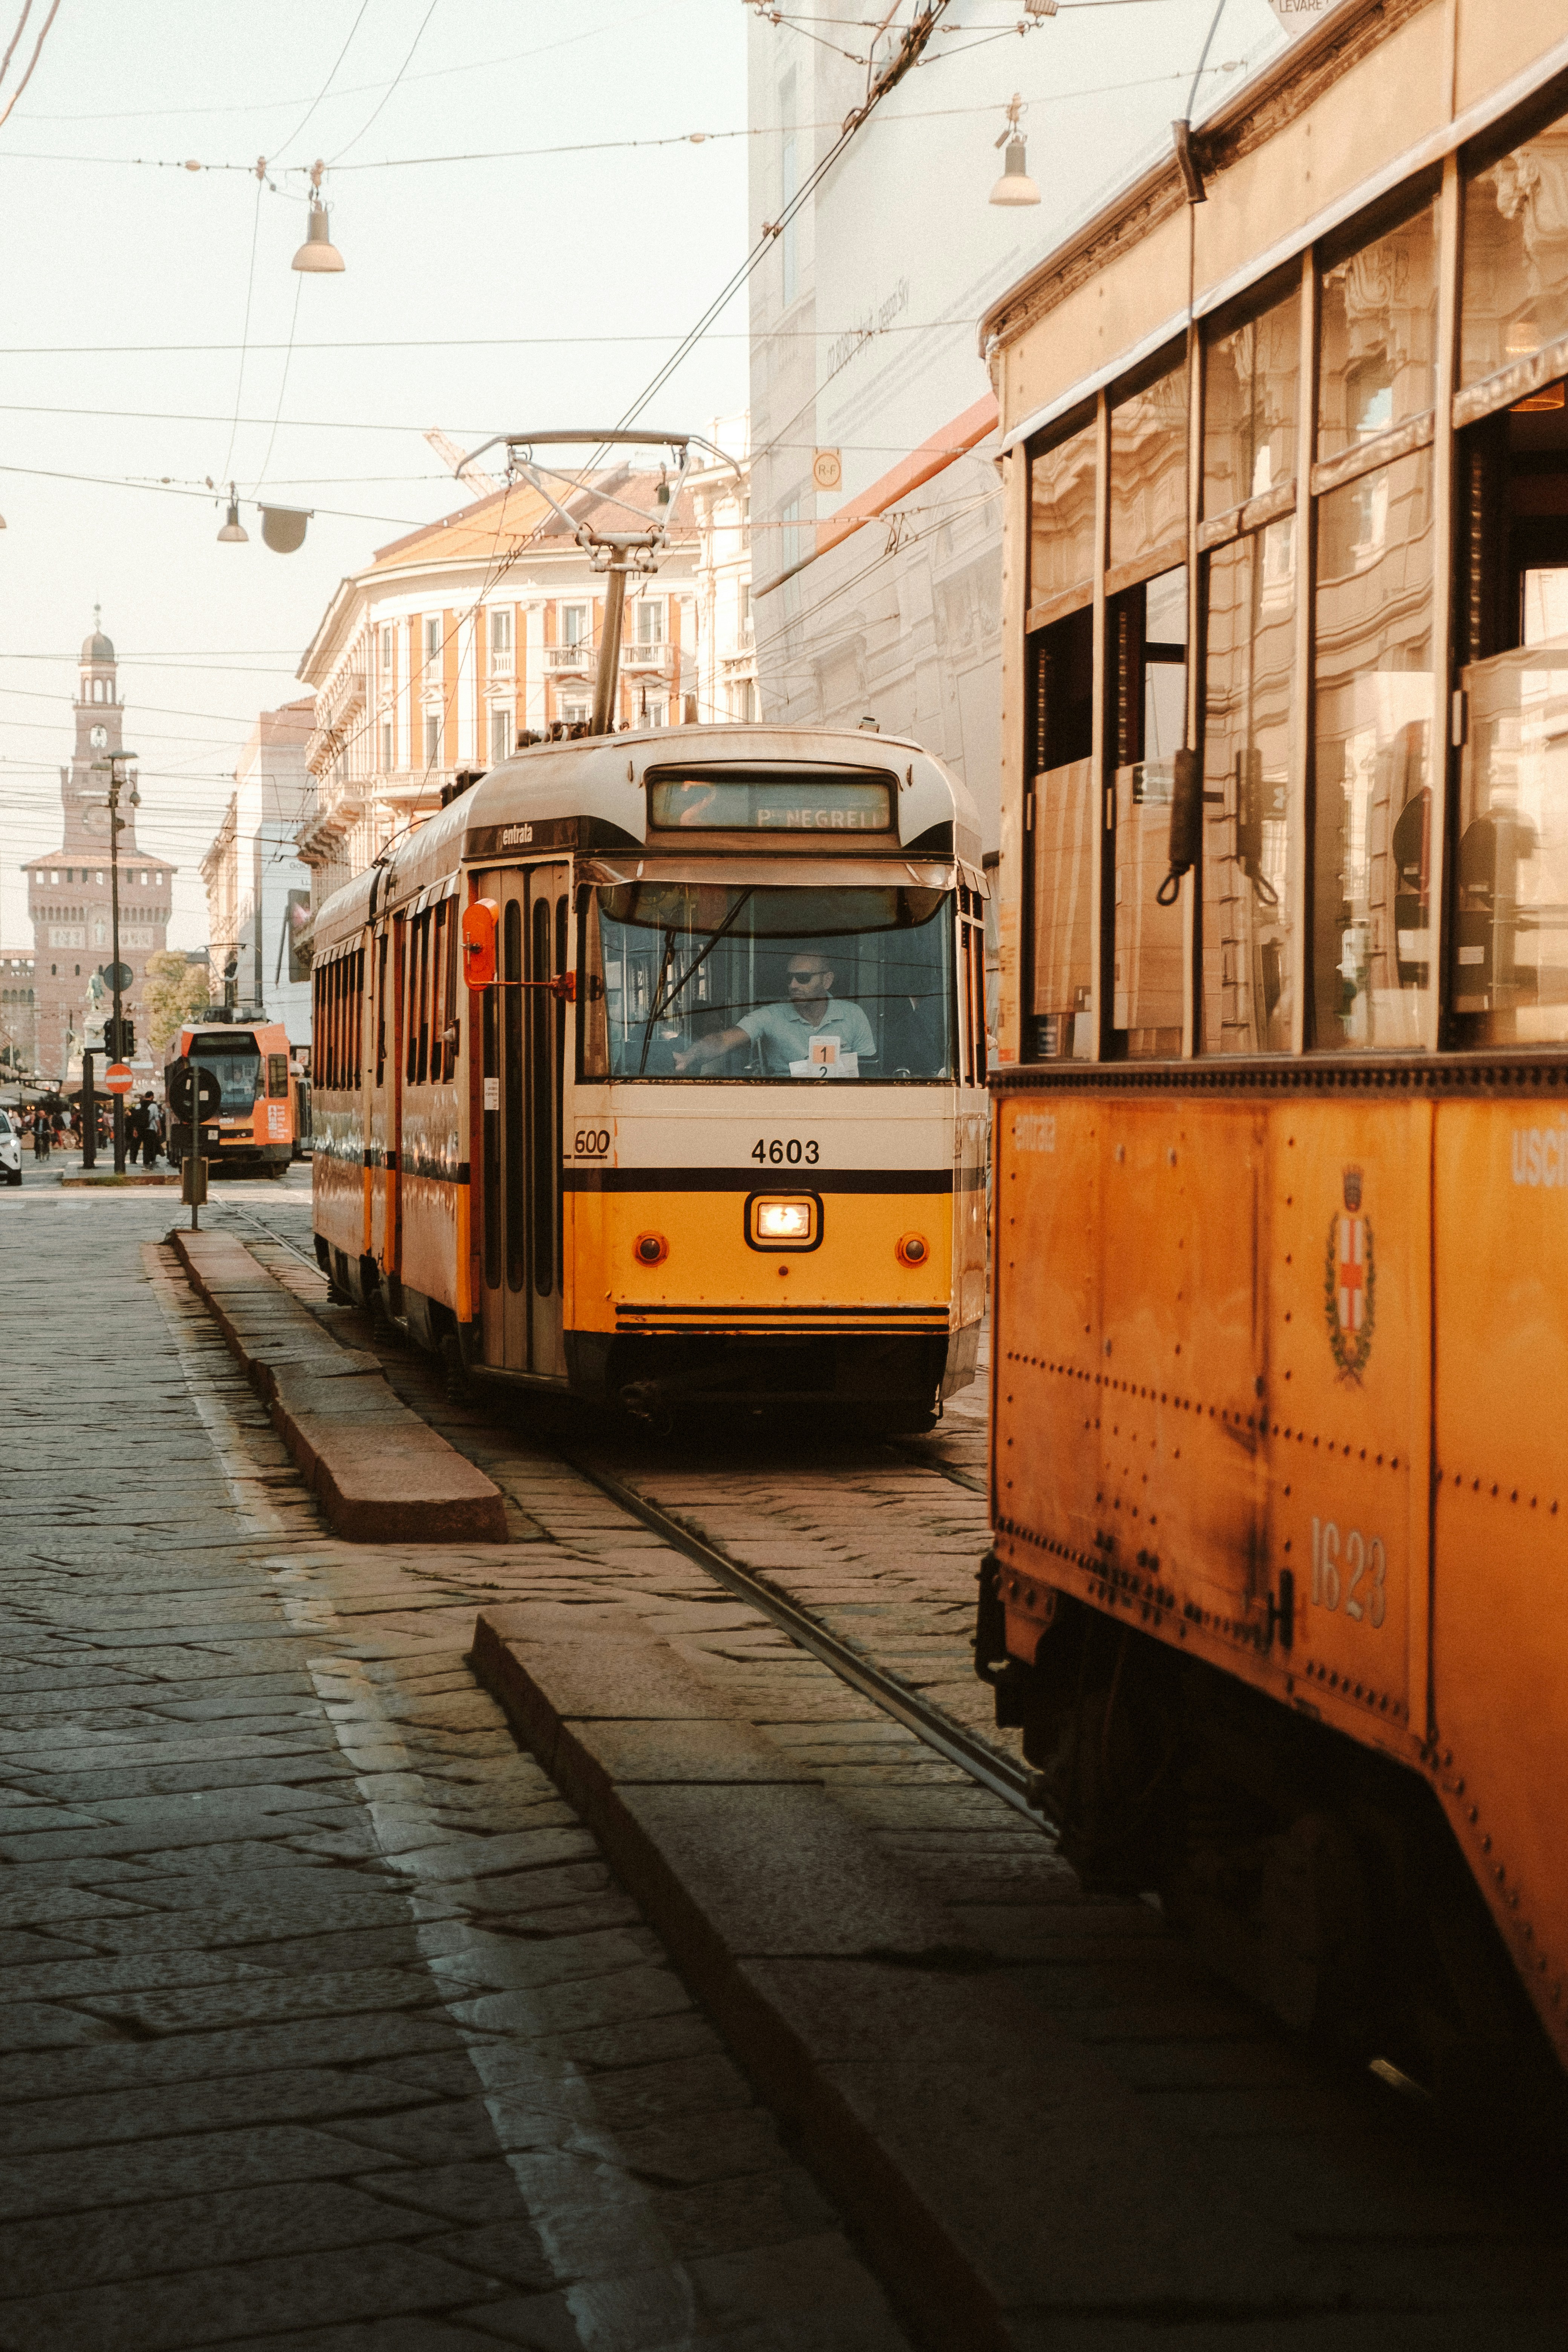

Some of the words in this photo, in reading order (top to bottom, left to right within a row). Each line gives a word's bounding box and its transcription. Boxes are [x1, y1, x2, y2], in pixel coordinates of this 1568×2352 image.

[1280, 0, 1322, 13] LEVARE
[503, 823, 532, 845] entrata
[820, 1046, 827, 1062] 1
[819, 1066, 827, 1077] 2
[575, 1130, 610, 1153] 600
[752, 1139, 819, 1164] 4603
[1312, 1516, 1386, 1629] 1623
